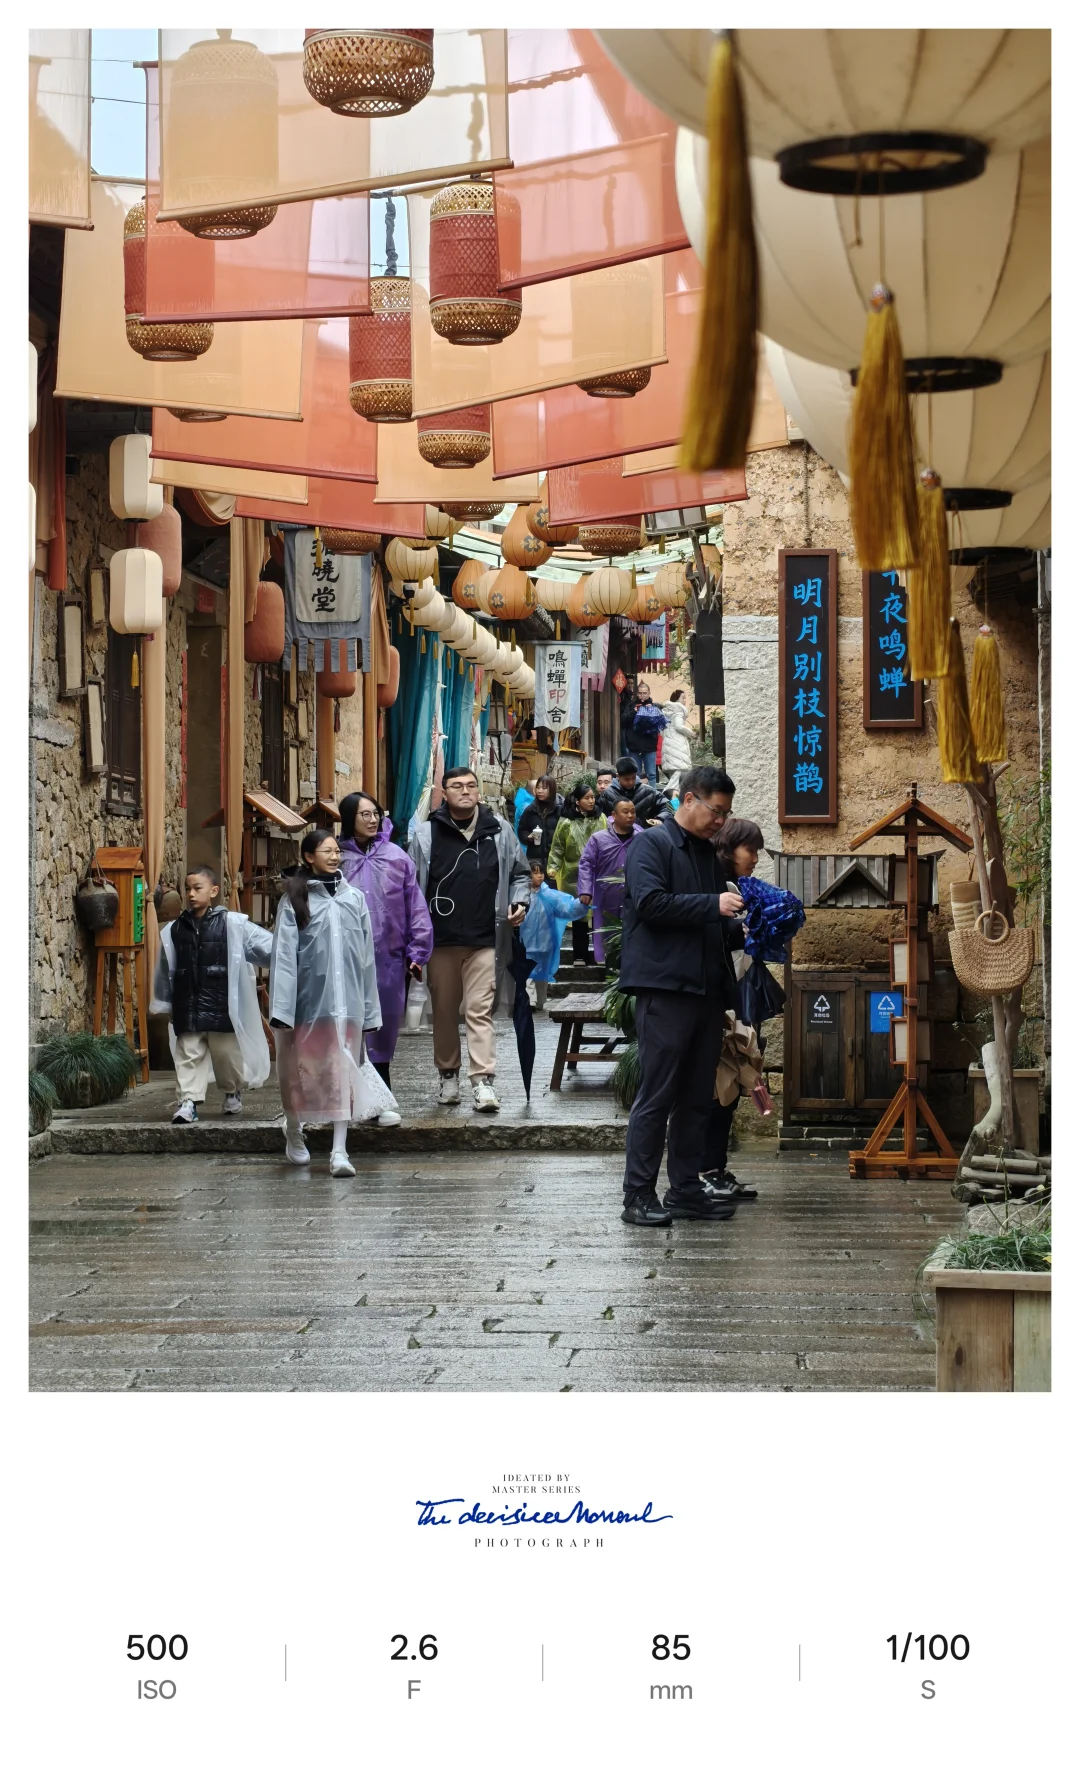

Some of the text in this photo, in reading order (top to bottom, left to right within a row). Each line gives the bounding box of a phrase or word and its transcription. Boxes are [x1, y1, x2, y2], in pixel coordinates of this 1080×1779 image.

[547, 649, 568, 724] 鳴蟬印舍
[792, 577, 826, 794] 明月别枝惊鹊
